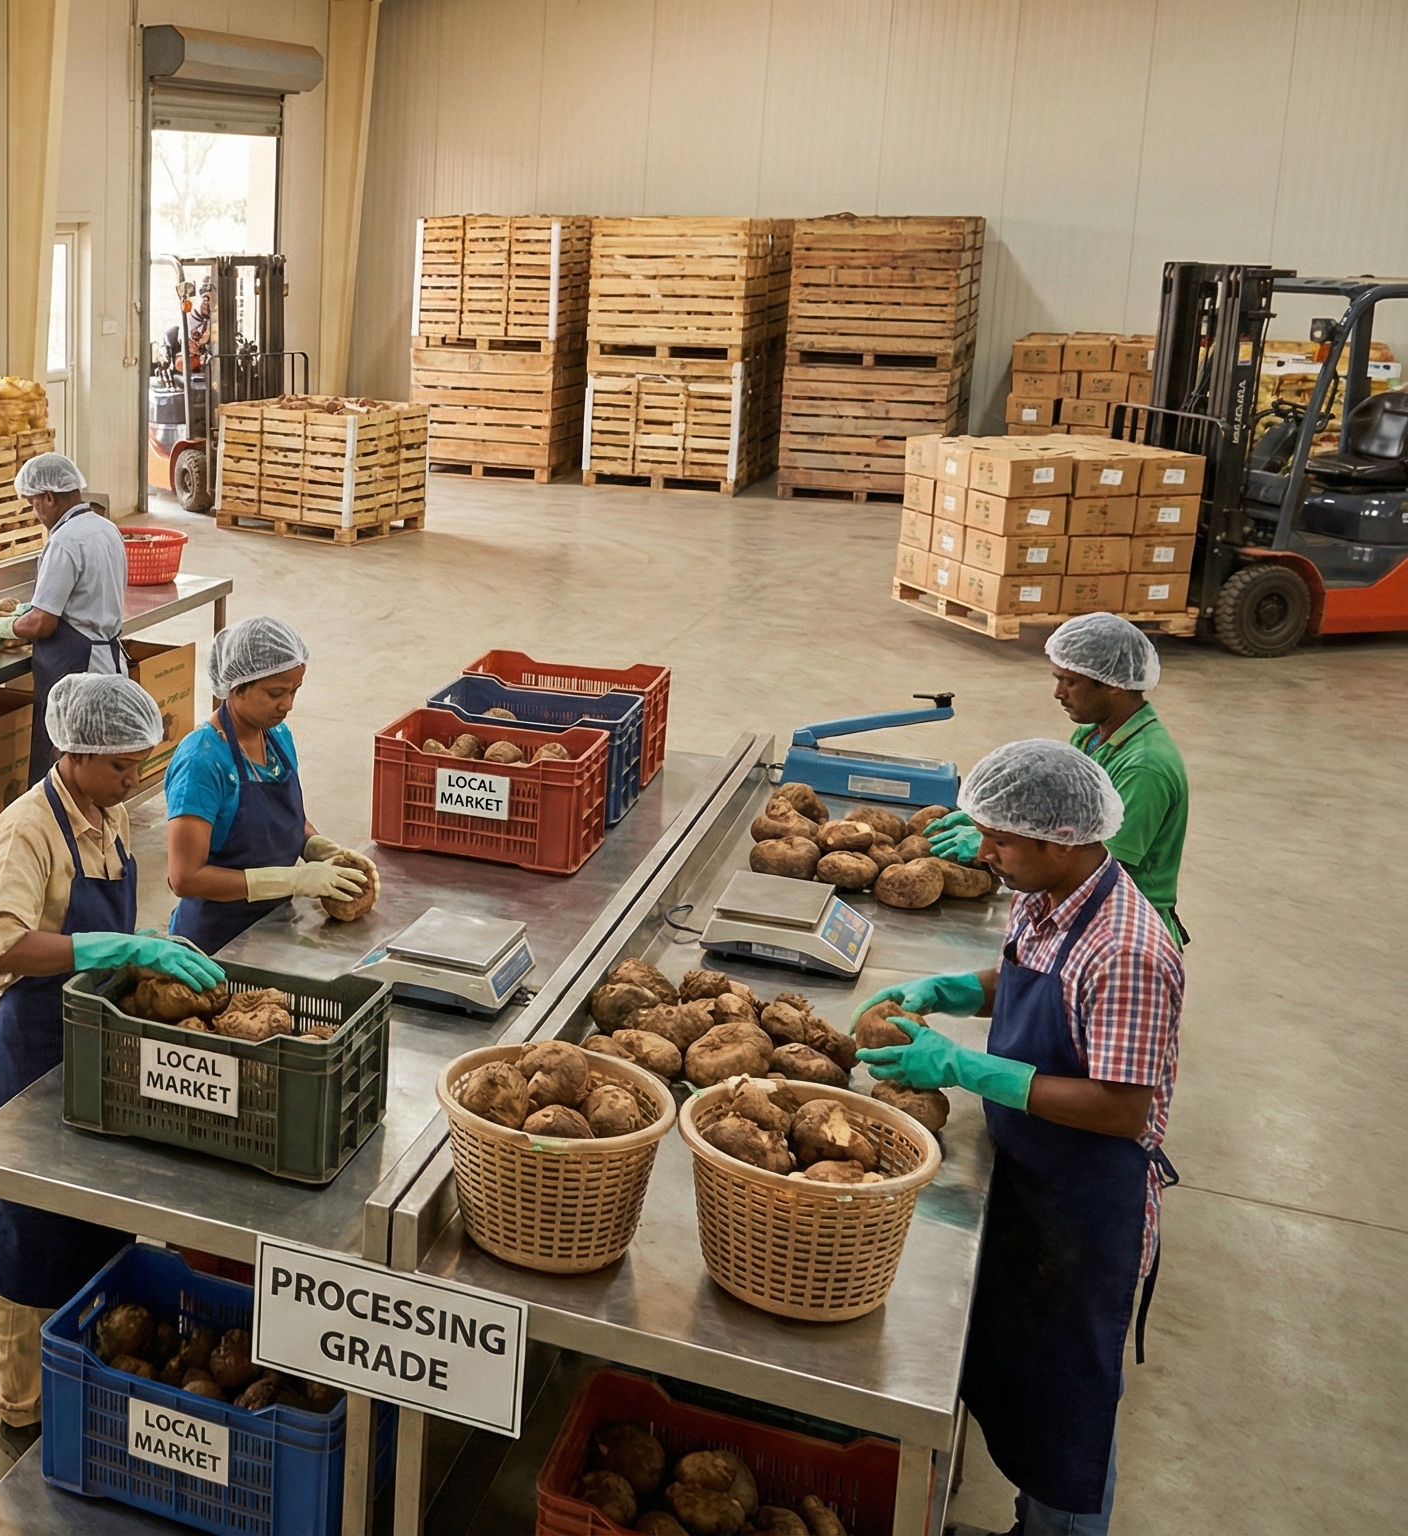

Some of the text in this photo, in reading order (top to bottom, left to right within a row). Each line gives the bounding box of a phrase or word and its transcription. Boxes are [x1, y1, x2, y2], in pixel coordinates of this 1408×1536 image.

[448, 775, 496, 793] LOCAL
[440, 792, 503, 812] MARKET
[157, 1047, 222, 1077] LOCAL
[146, 1070, 231, 1104] MARKET
[271, 1266, 506, 1355] PROCESSING
[320, 1330, 449, 1391] GRADE
[144, 1409, 212, 1446] LOCAL
[134, 1431, 222, 1473] MARKET
